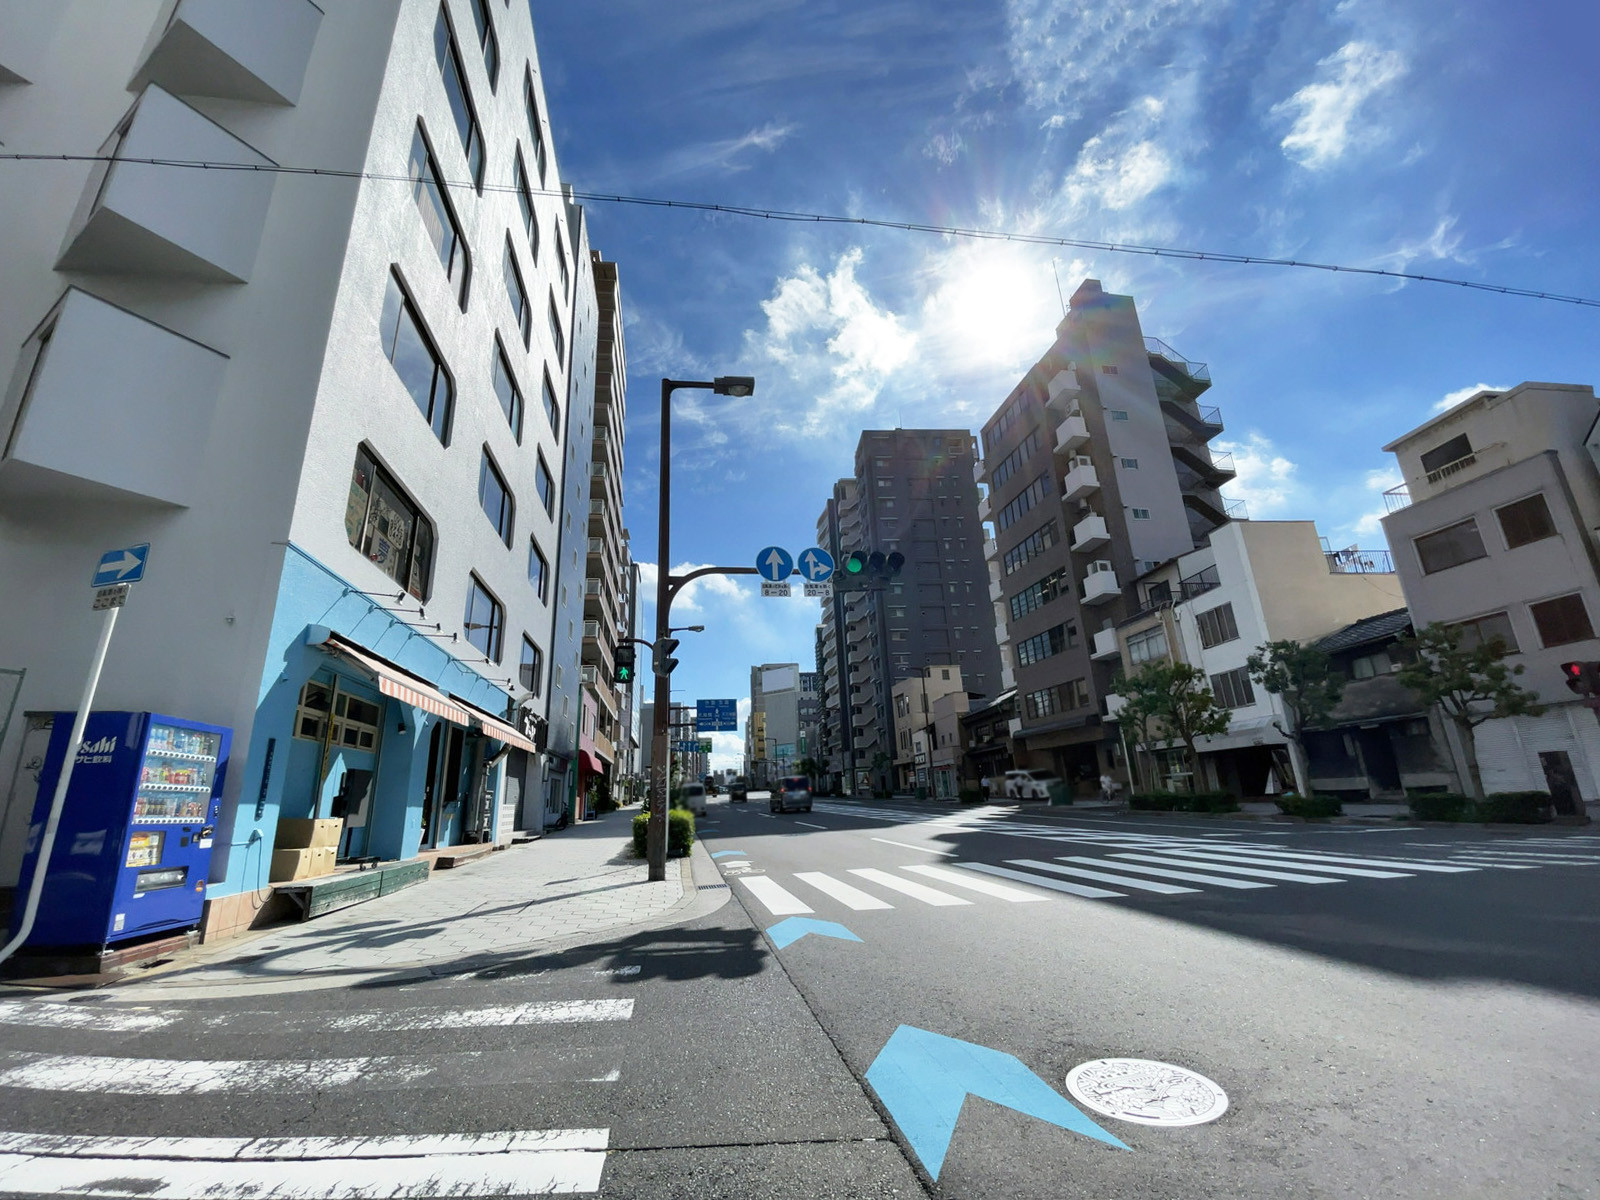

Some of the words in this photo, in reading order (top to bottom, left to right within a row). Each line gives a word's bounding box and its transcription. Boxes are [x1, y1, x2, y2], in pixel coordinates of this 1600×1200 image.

[81, 736, 117, 753] sahi
[76, 755, 112, 763] サヒ飲料
